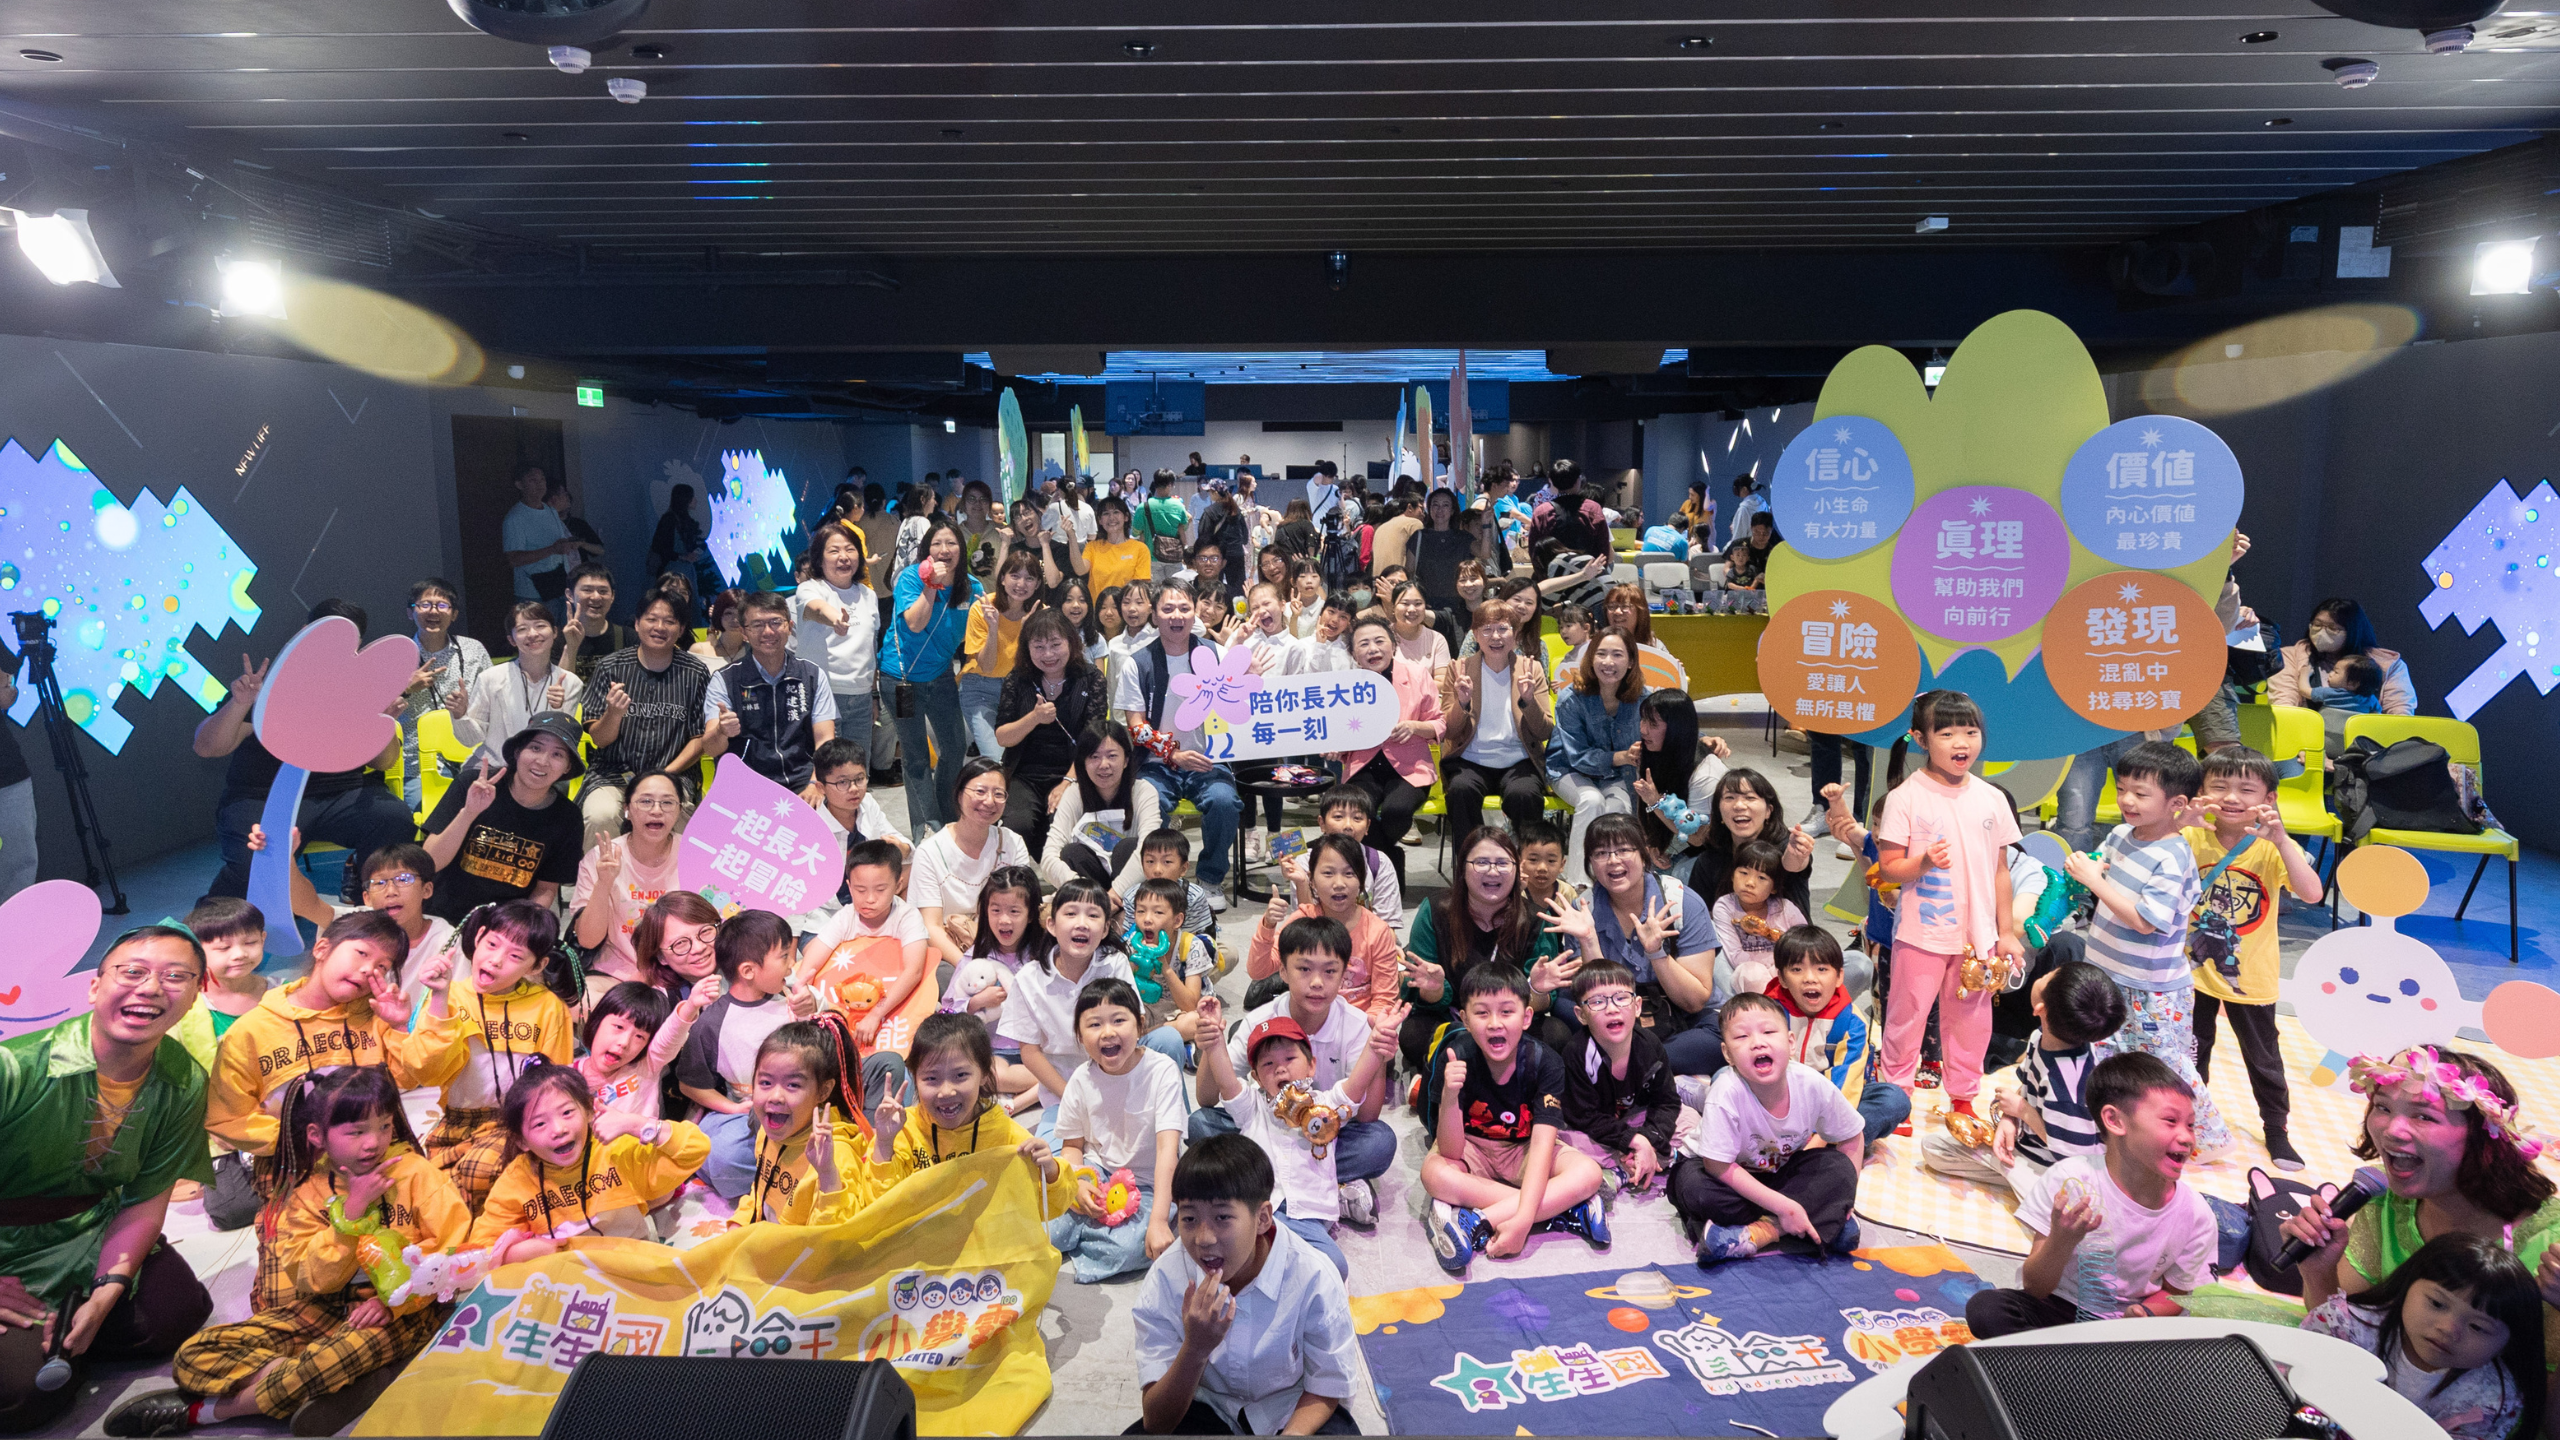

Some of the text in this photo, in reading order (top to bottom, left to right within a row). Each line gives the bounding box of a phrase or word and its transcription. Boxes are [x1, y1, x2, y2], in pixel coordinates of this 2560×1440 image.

[1805, 447, 1879, 482] 信心
[1813, 496, 1869, 515] 小生命
[1804, 521, 1878, 539] 有大力量
[2116, 531, 2183, 551] 最珍貴
[1933, 577, 2024, 599] 幫助我們
[1944, 606, 2011, 627] 向前行
[2085, 605, 2179, 646] 發現
[1801, 621, 1879, 660] 冒險
[1806, 672, 1866, 694] 愛讓人
[2098, 661, 2169, 683] 混亂中
[1250, 681, 1377, 716] 陪你長大的
[1795, 698, 1876, 721] 無所畏懼
[2088, 690, 2182, 711] 找尋珍寶
[622, 700, 688, 721] ONKEYS
[1252, 716, 1328, 745] 每一刻
[709, 802, 826, 876] 一起長大
[688, 836, 808, 911] 一起冒險
[1261, 1022, 1270, 1032] B
[258, 1030, 377, 1077] DRAECOM
[1706, 1371, 1850, 1393] kid adventurers
